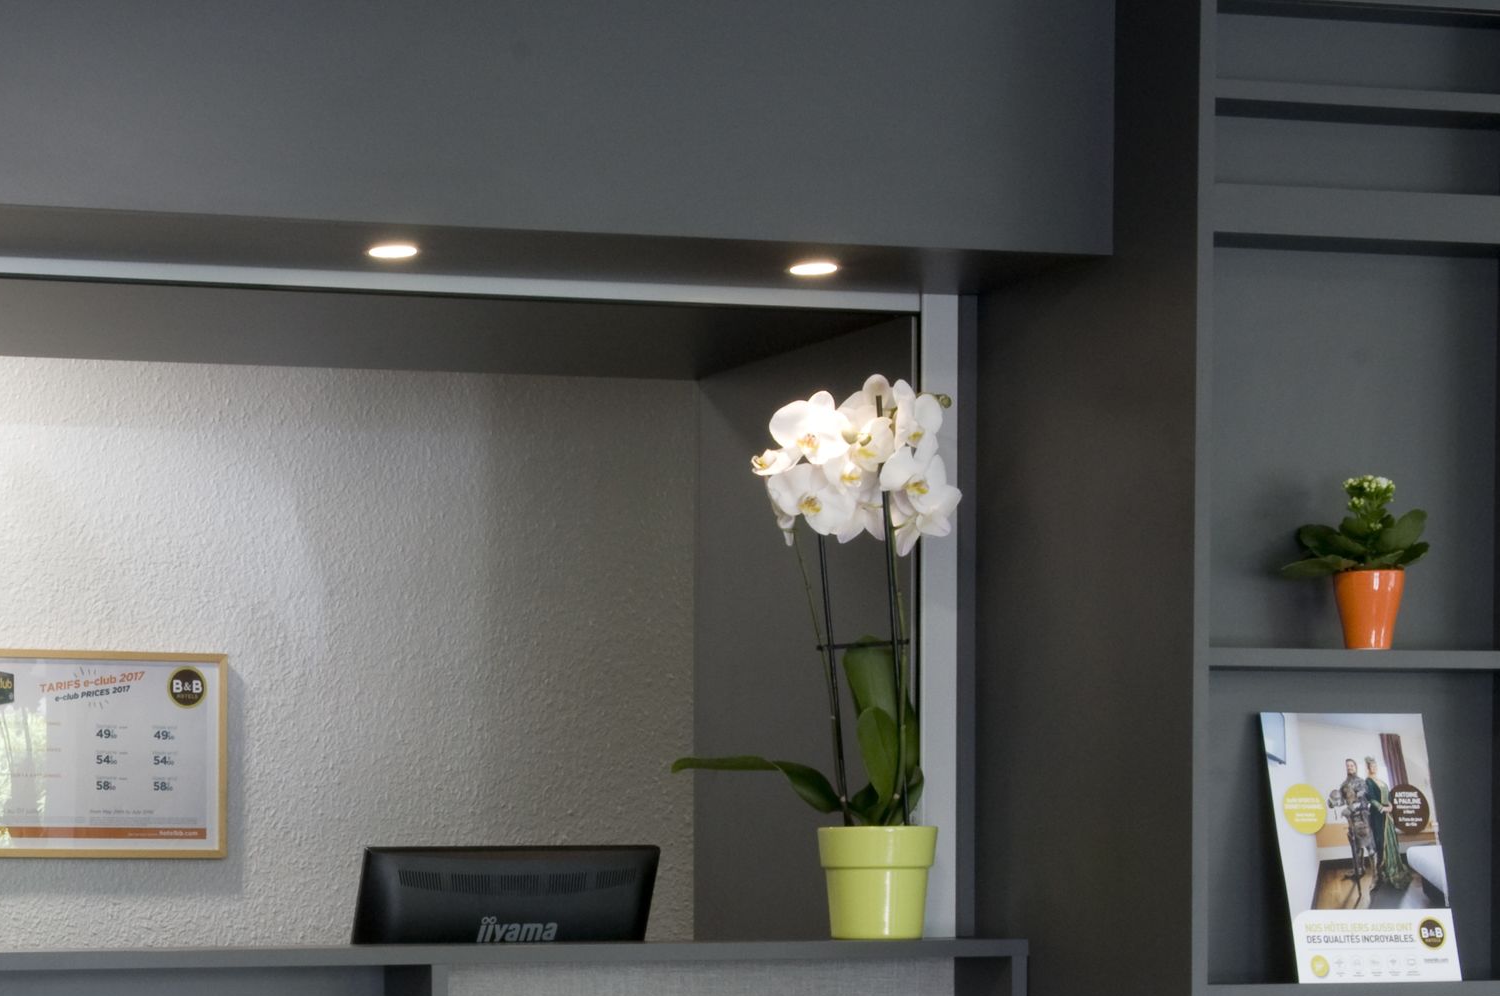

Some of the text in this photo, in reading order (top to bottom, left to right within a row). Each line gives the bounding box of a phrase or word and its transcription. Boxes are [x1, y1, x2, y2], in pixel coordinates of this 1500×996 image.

[39, 671, 145, 693] TARIFS e-club 2017
[173, 680, 202, 693] B&B
[55, 685, 131, 702] e-club PRICES 2017
[476, 916, 558, 942] iiyama
[1305, 923, 1324, 932] NOS
[1421, 927, 1444, 938] B&B
[1306, 935, 1322, 943] DES
[1323, 933, 1360, 944] QUALITÉS
